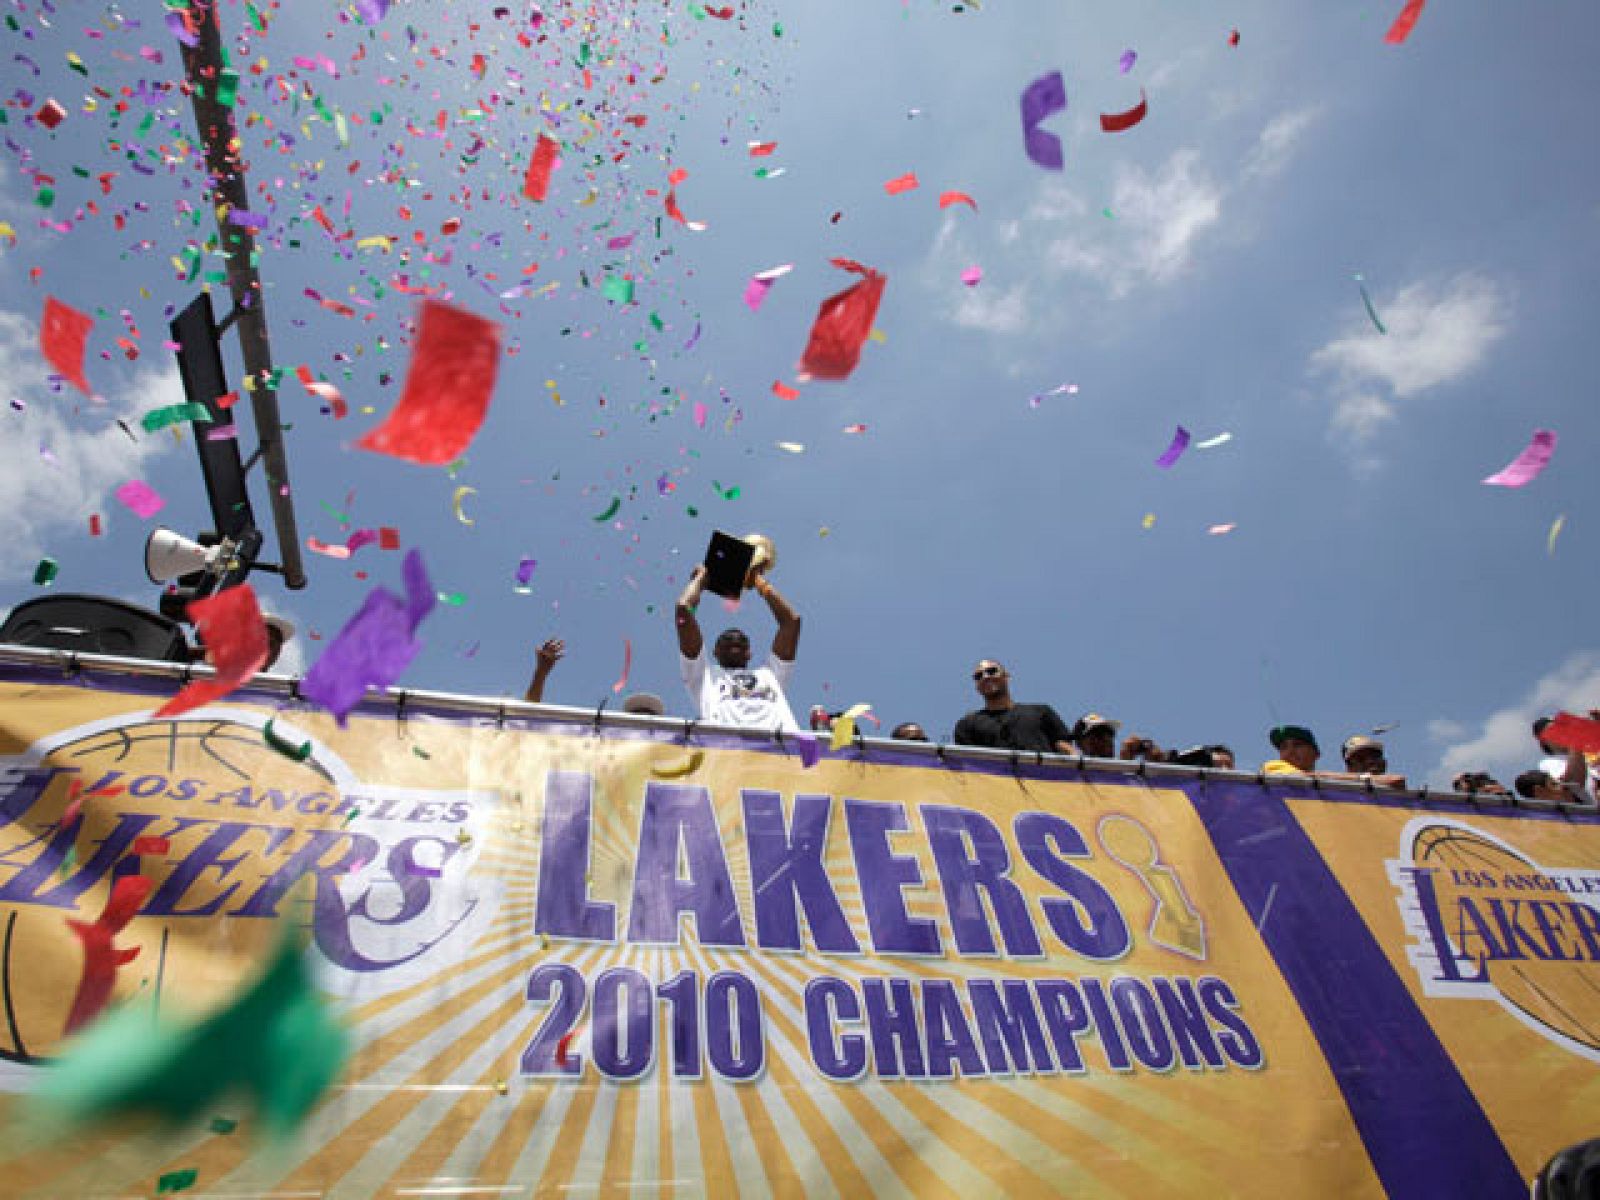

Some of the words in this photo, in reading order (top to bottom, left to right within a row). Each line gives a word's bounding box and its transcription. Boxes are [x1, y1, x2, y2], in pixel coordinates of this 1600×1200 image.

[0, 767, 479, 972] AKERS
[83, 770, 208, 801] LOS
[203, 786, 474, 823] ANGELES
[534, 771, 1131, 959] LAKERS
[519, 964, 764, 1078] 2010
[804, 975, 1265, 1079] CHAMPIONS
